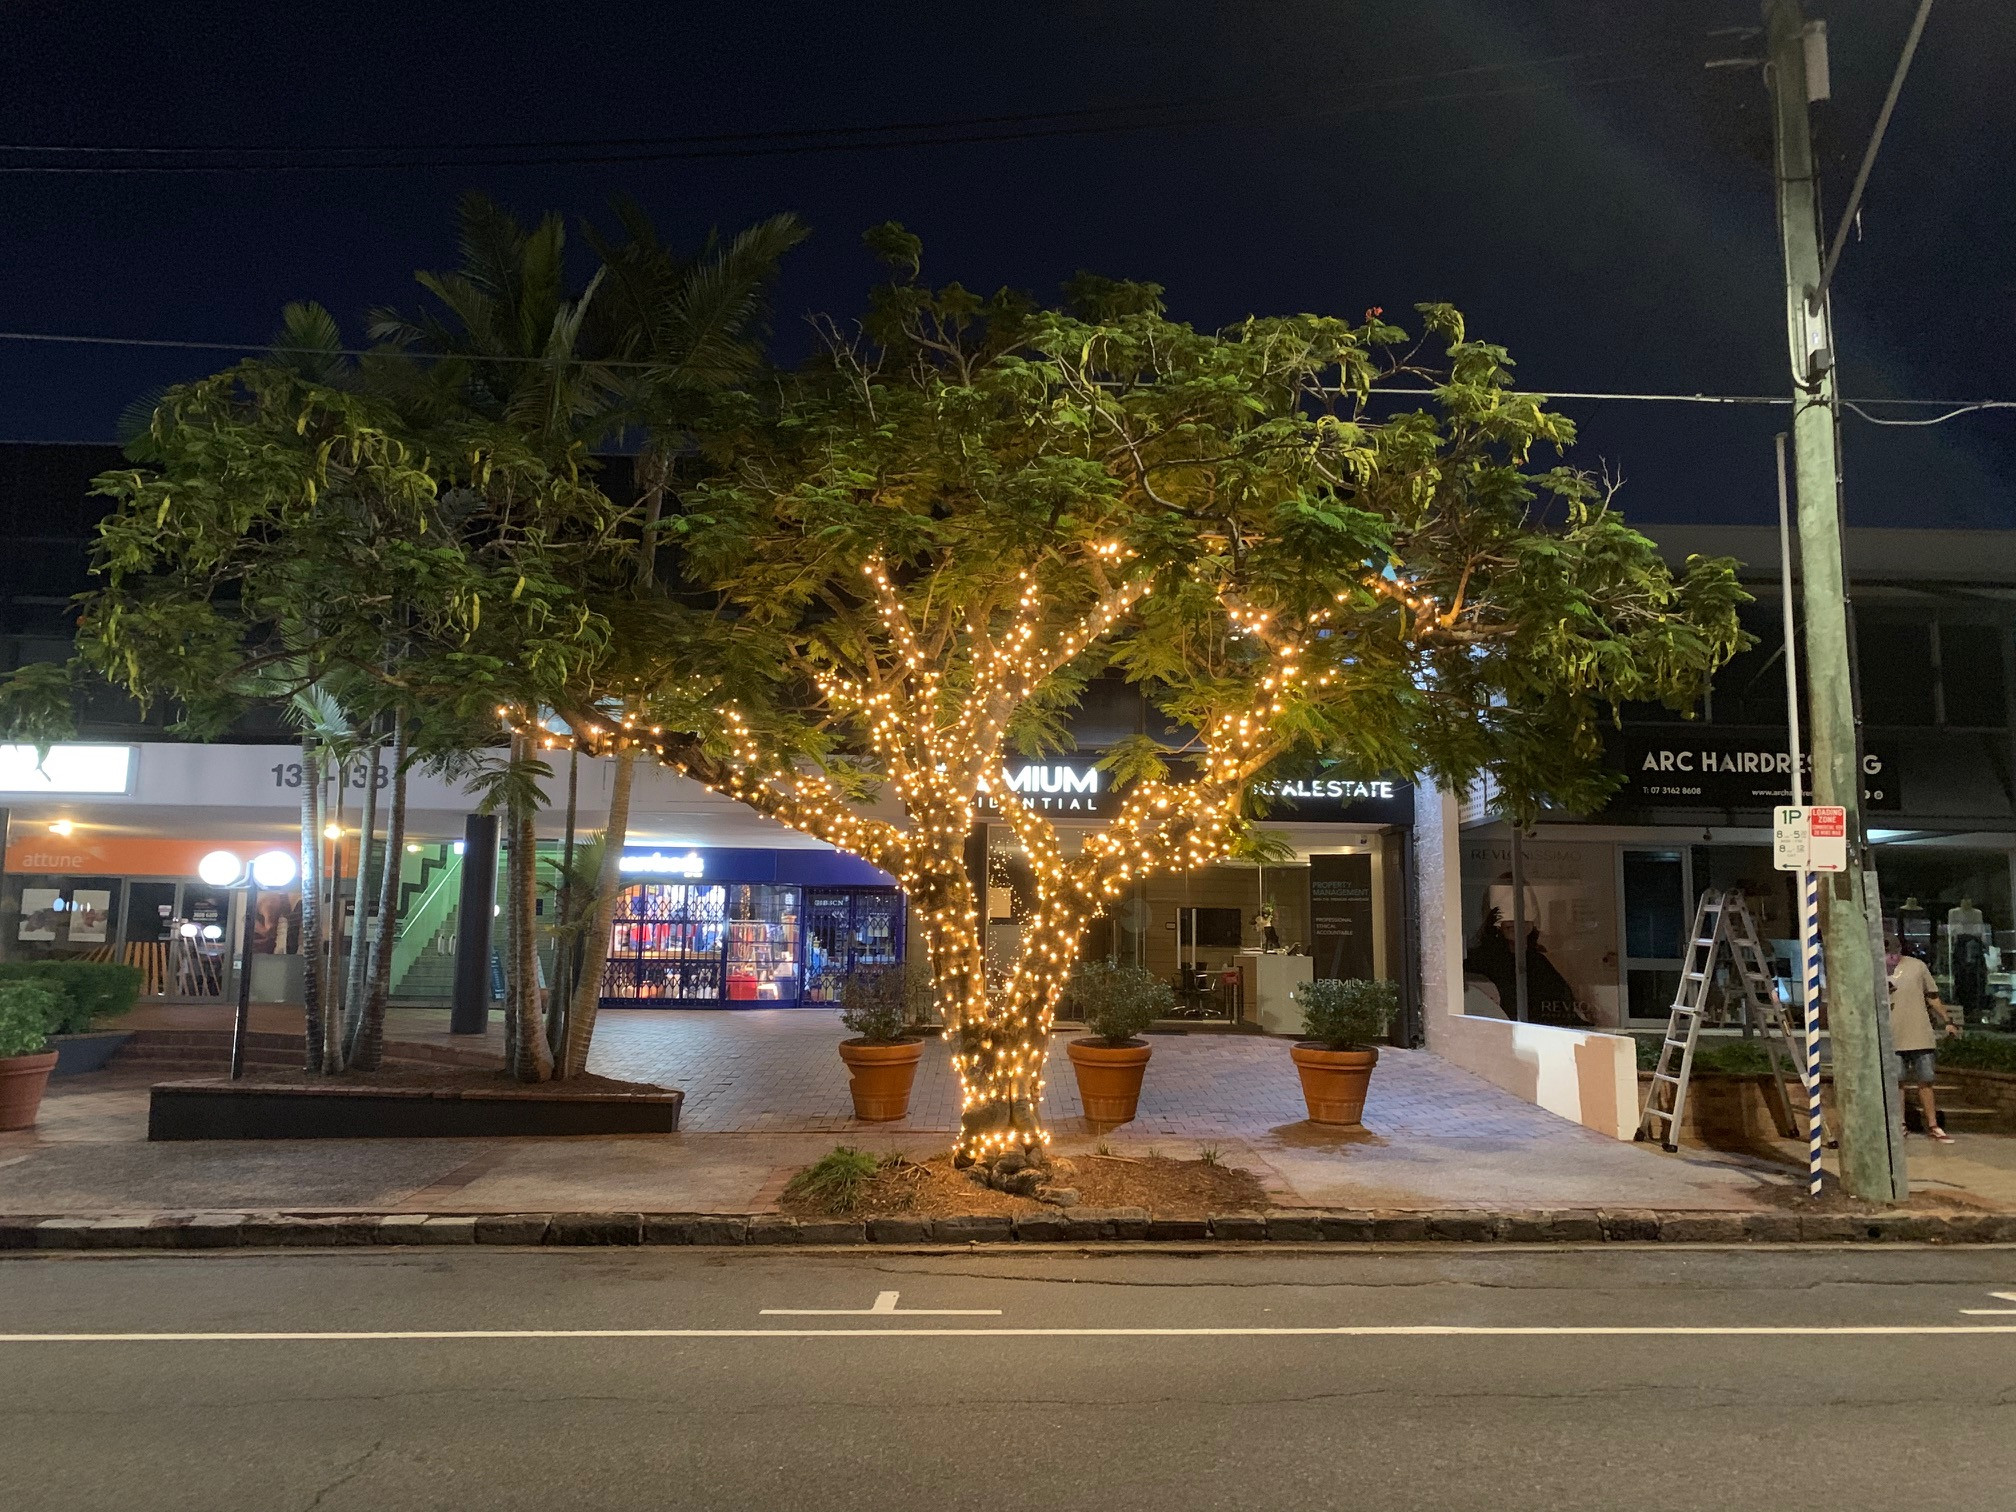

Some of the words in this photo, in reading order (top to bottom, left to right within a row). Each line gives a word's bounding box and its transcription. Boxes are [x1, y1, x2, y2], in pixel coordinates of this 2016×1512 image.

[1642, 751, 1693, 771] ARC
[1650, 786, 1660, 794] 07
[1662, 787, 1681, 795] 3162
[1681, 787, 1702, 795] 8608
[1782, 810, 1801, 824] 1P
[22, 853, 84, 867] attune
